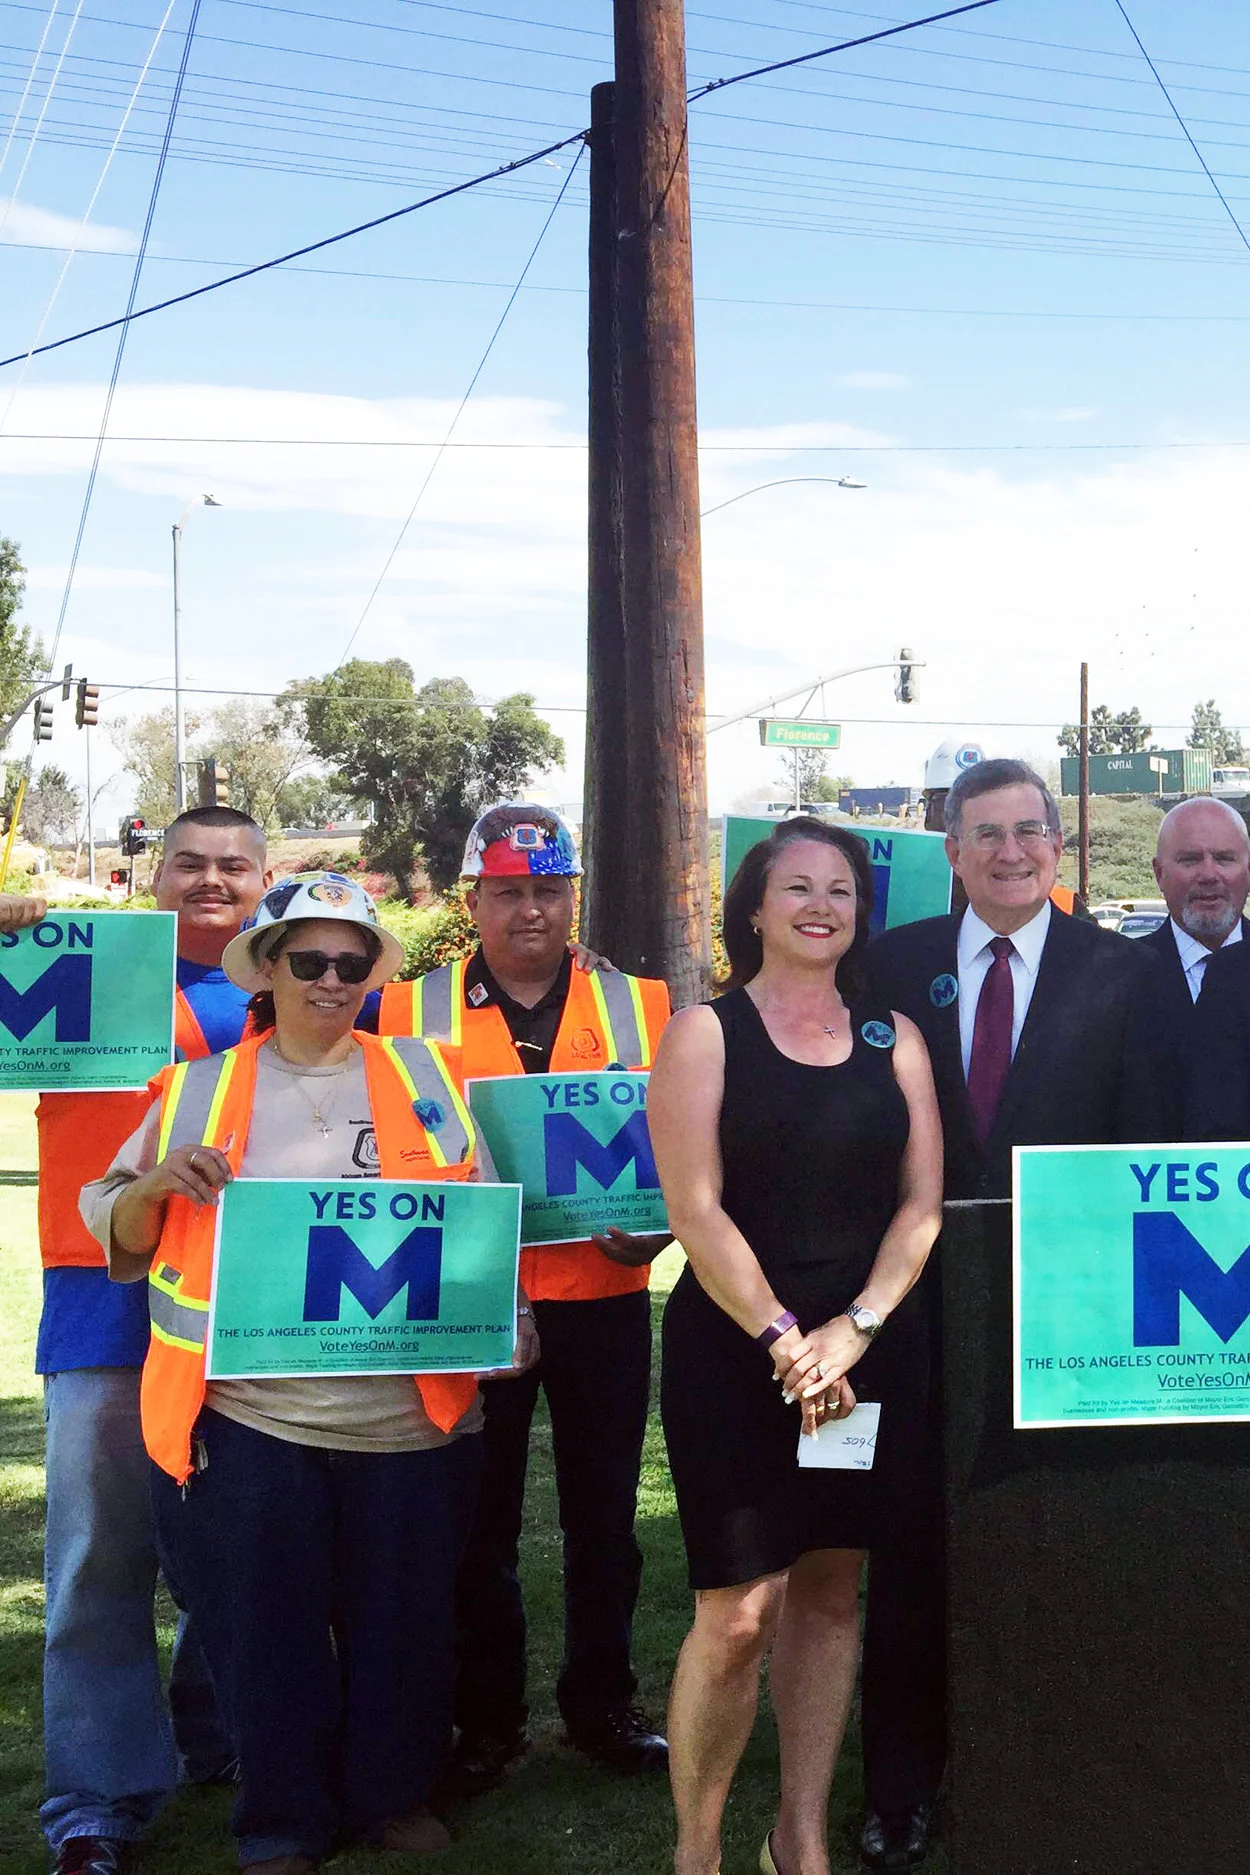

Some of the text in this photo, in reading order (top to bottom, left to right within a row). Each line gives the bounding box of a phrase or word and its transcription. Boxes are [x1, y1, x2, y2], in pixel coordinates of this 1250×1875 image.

[776, 727, 829, 741] Florence
[1107, 760, 1134, 770] CAPITAL
[33, 921, 94, 948] ON
[15, 1047, 59, 1057] TRAFFIC
[63, 1046, 138, 1055] IMPROVEMENT
[141, 1046, 169, 1054] PLAN
[540, 1082, 600, 1108] YES
[544, 1109, 662, 1197] M
[1130, 1161, 1219, 1203] YES
[309, 1191, 445, 1221] YES ON
[563, 1196, 601, 1208] COUNTY
[604, 1193, 641, 1205] TRAFFIC
[302, 1225, 444, 1322] M
[217, 1323, 511, 1338] THE LOS ANGELES COUNTY TRAFFIC IMPROVEMENT PLAN
[320, 1339, 420, 1353] VoteYesOnM.org
[1026, 1357, 1053, 1370] THE
[1059, 1356, 1085, 1369] LOS
[1089, 1354, 1151, 1368] ANGELES
[1156, 1353, 1215, 1366] COUNTY
